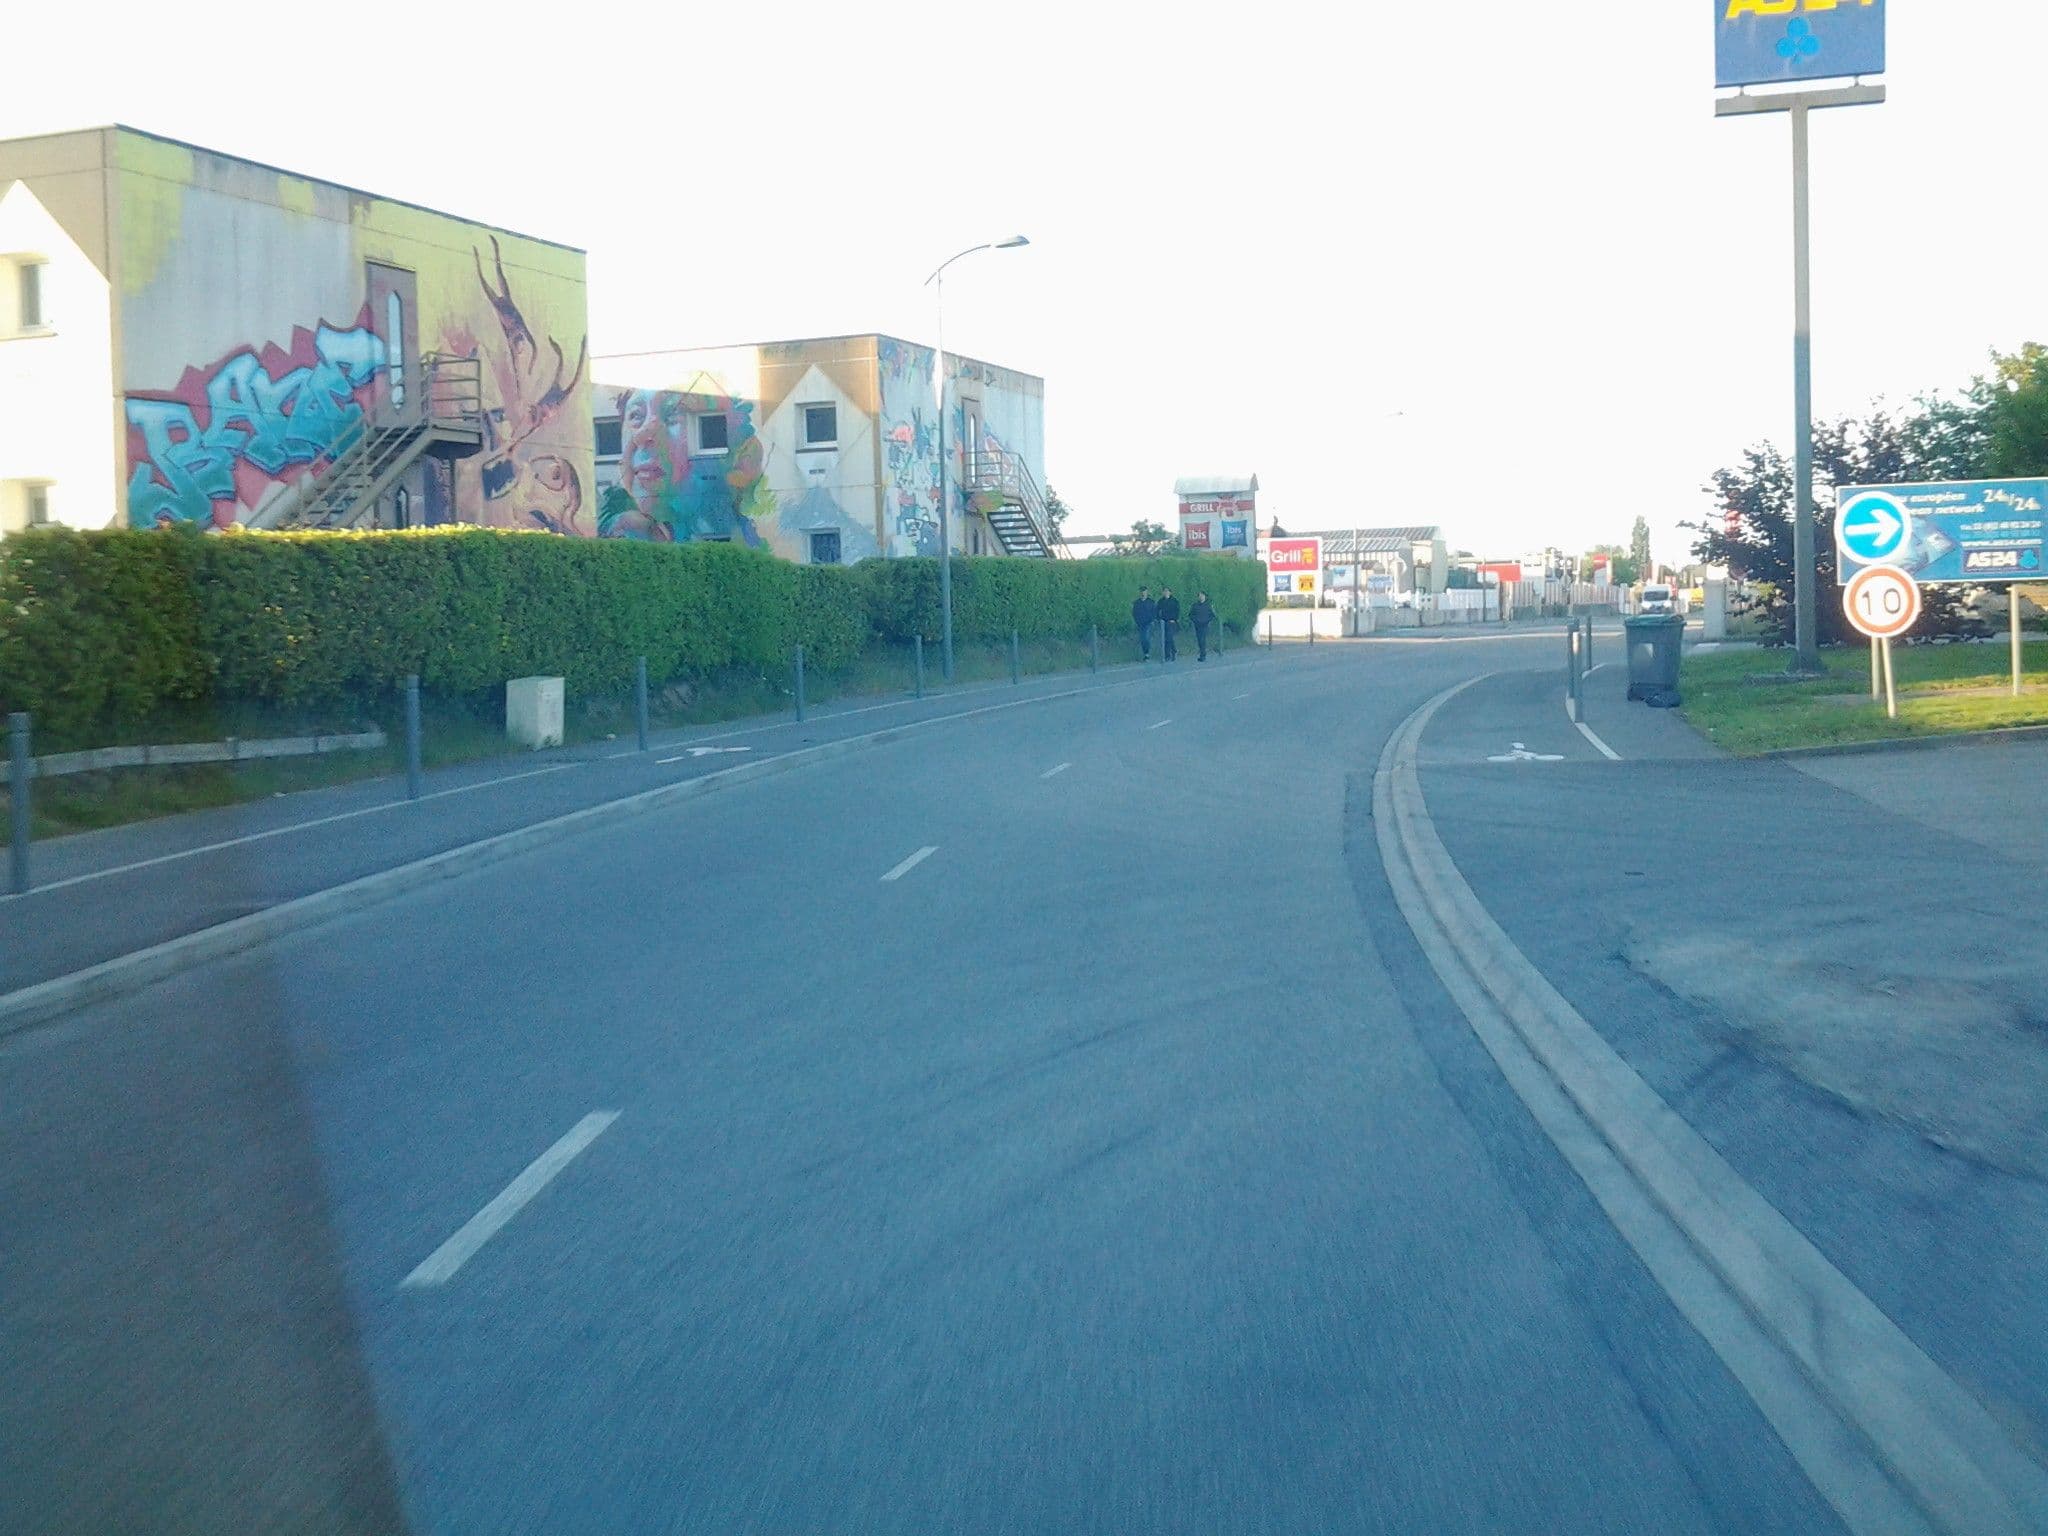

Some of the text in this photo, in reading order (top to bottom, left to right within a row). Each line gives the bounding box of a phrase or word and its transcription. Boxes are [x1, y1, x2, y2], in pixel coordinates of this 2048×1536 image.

[1190, 504, 1214, 512] GRILL
[1188, 529, 1207, 540] ibis
[1272, 550, 1300, 563] Grill
[1967, 551, 2017, 567] AS24
[1862, 589, 1900, 615] 10
